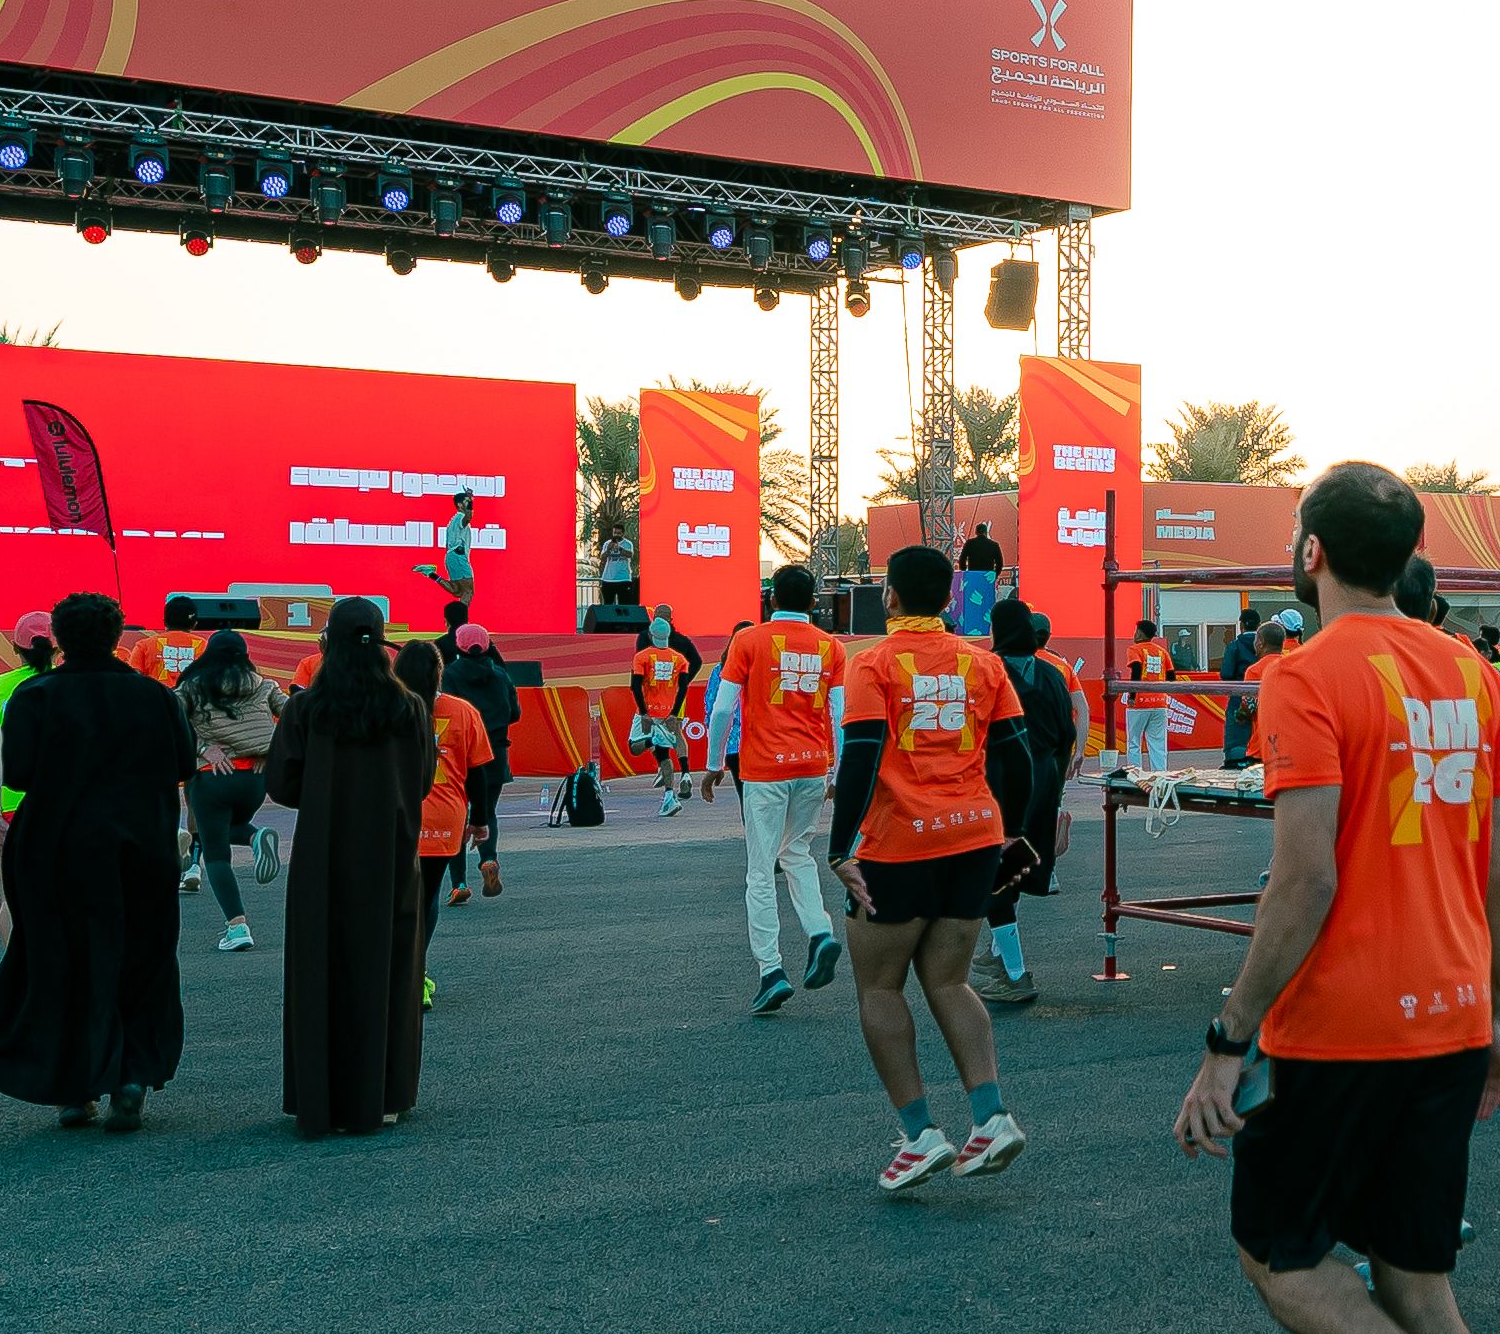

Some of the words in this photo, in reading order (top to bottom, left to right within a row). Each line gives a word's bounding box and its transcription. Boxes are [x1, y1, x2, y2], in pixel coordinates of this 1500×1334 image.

[991, 48, 1047, 68] SPORTS
[1050, 57, 1077, 72] FOR
[1079, 62, 1104, 76] ALL
[991, 66, 1048, 85] للجميع
[1050, 75, 1105, 95] الرياضة
[1053, 444, 1082, 459] THE
[1083, 446, 1116, 461] FUN
[672, 467, 701, 479] THE
[1054, 457, 1116, 473] BEGINS
[53, 440, 83, 524] lululemon
[674, 478, 734, 492] BEGINS
[1156, 525, 1216, 541] MEDIA
[288, 602, 311, 626] 1
[163, 645, 195, 659] RM
[780, 651, 822, 673] RM
[779, 671, 820, 694] 26
[912, 674, 967, 701] RM
[909, 701, 967, 731] 26
[1401, 697, 1479, 750] RM
[1412, 752, 1478, 804] 26
